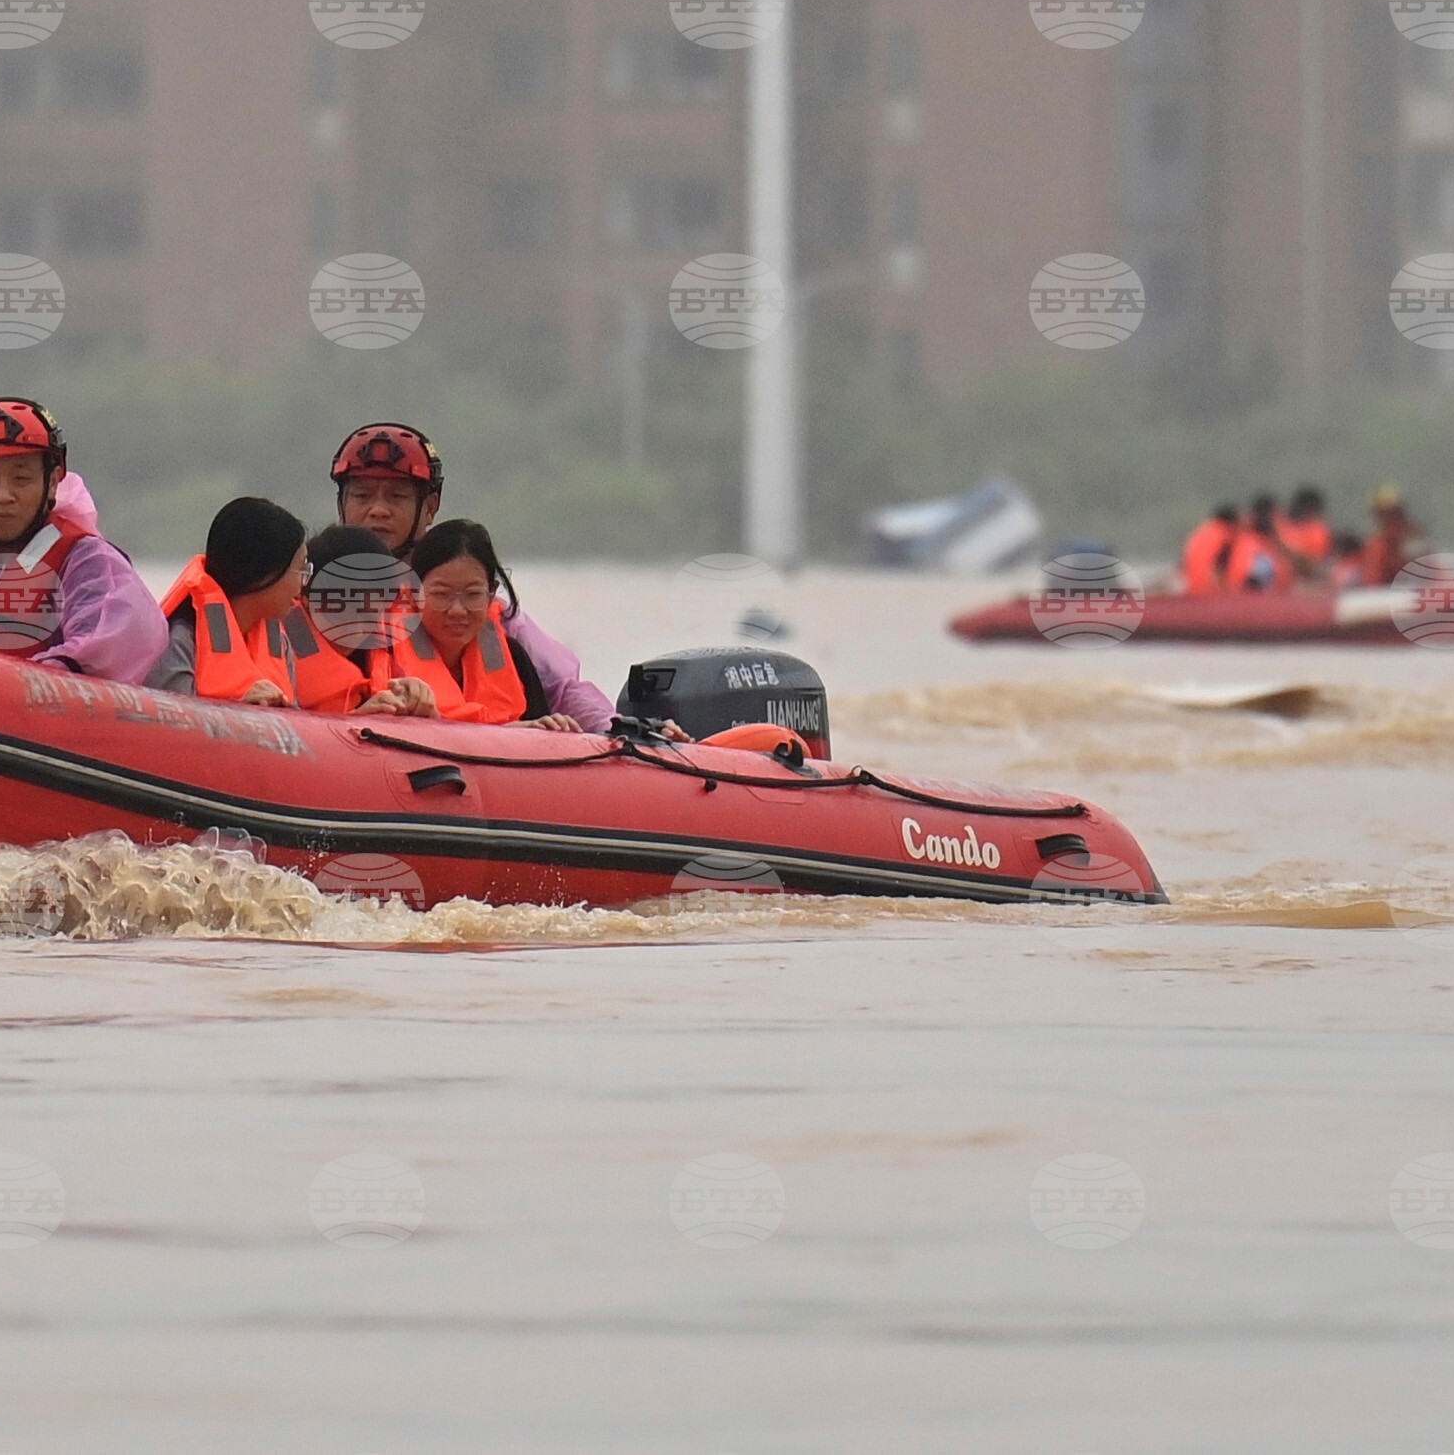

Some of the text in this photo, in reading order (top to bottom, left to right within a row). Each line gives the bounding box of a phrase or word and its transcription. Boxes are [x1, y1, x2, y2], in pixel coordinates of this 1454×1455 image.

[725, 661, 779, 689] 湘中应急
[901, 817, 1001, 869] Cando
